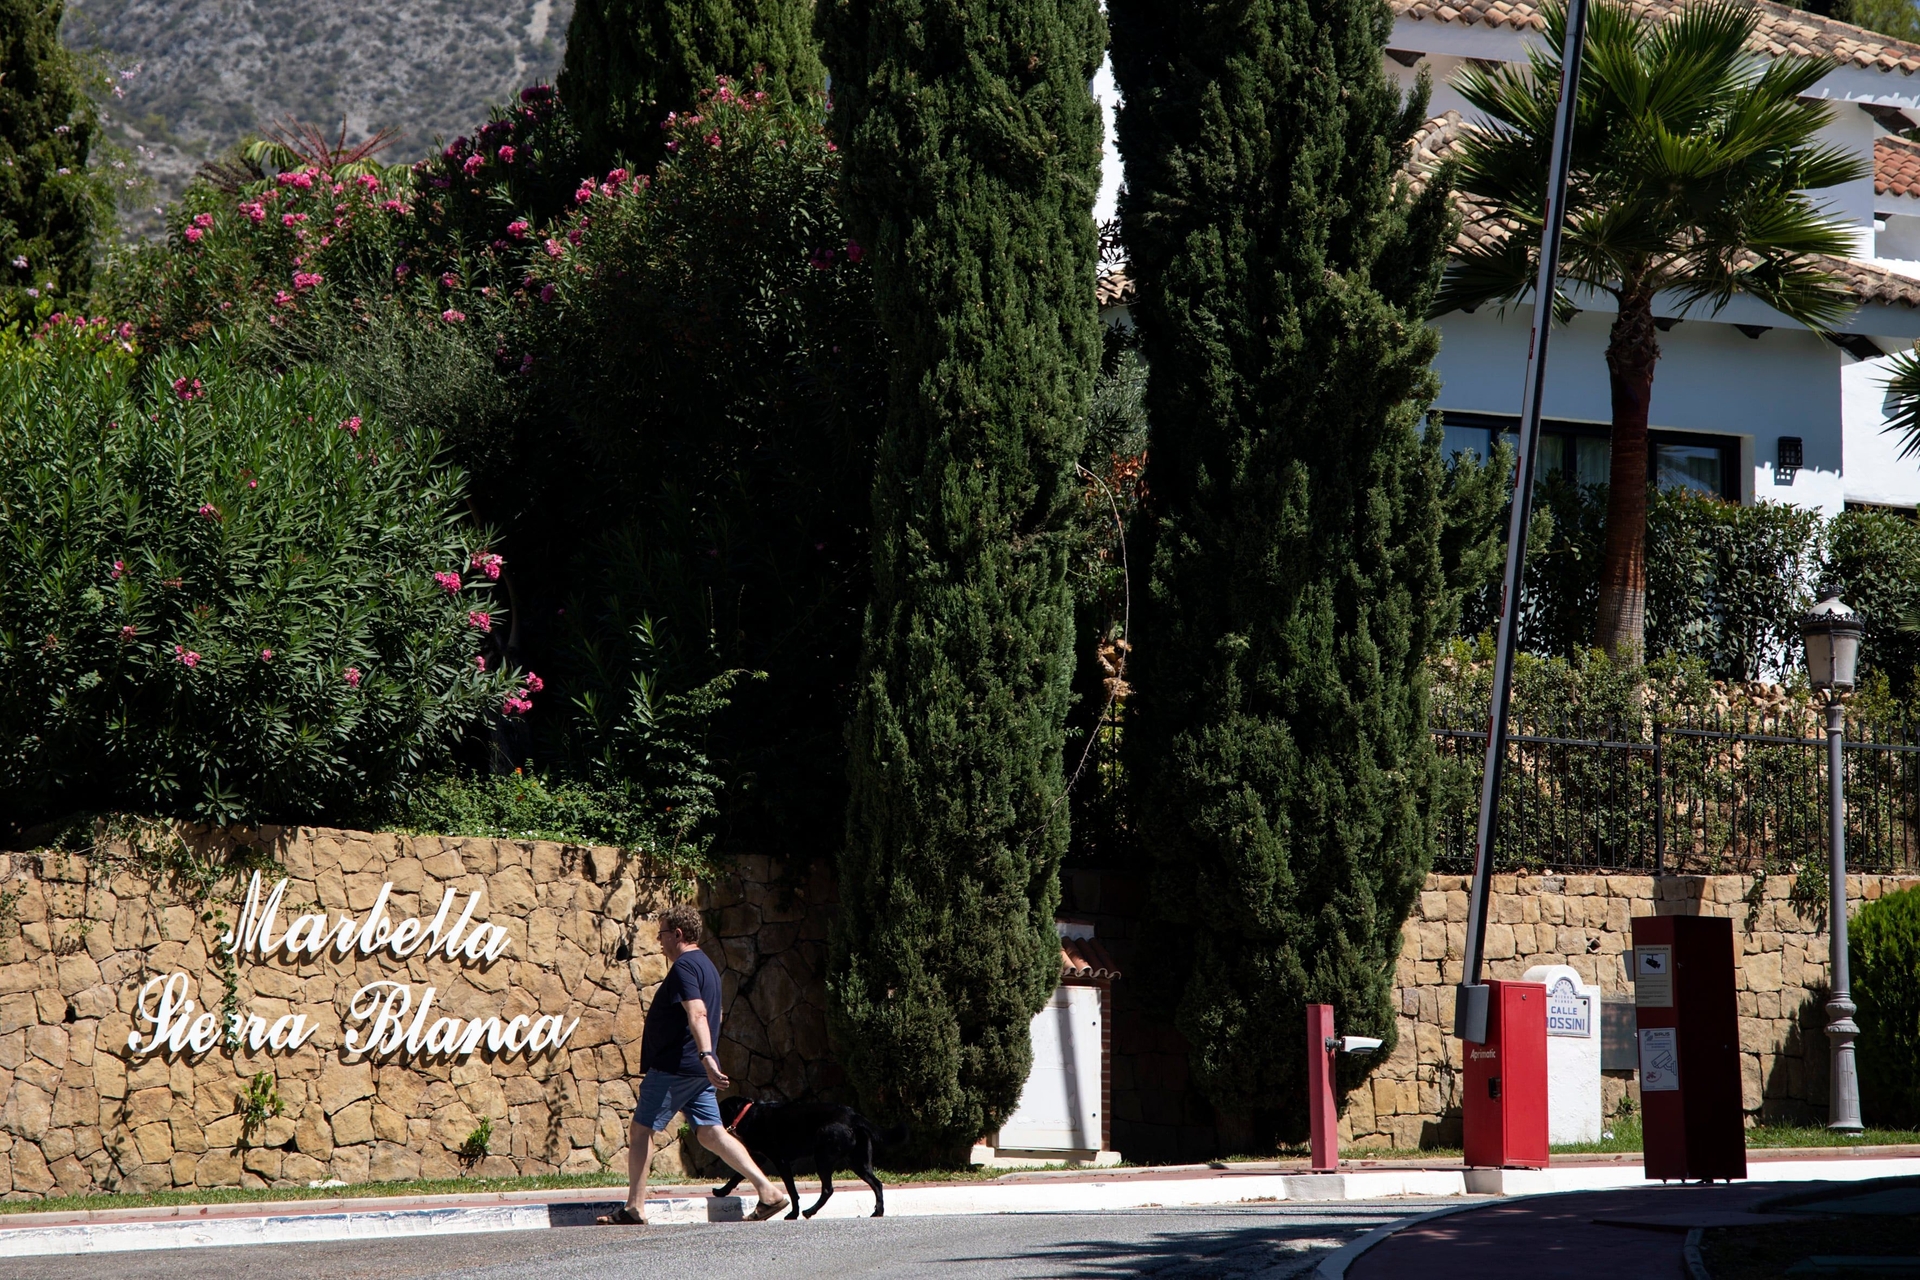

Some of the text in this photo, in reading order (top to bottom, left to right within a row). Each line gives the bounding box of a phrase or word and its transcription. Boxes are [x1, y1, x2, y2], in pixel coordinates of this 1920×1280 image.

[221, 869, 511, 962] Marbella
[345, 981, 580, 1055] Blanca
[1551, 1006, 1577, 1015] CALLE
[1470, 1048, 1496, 1062] Aprimatic
